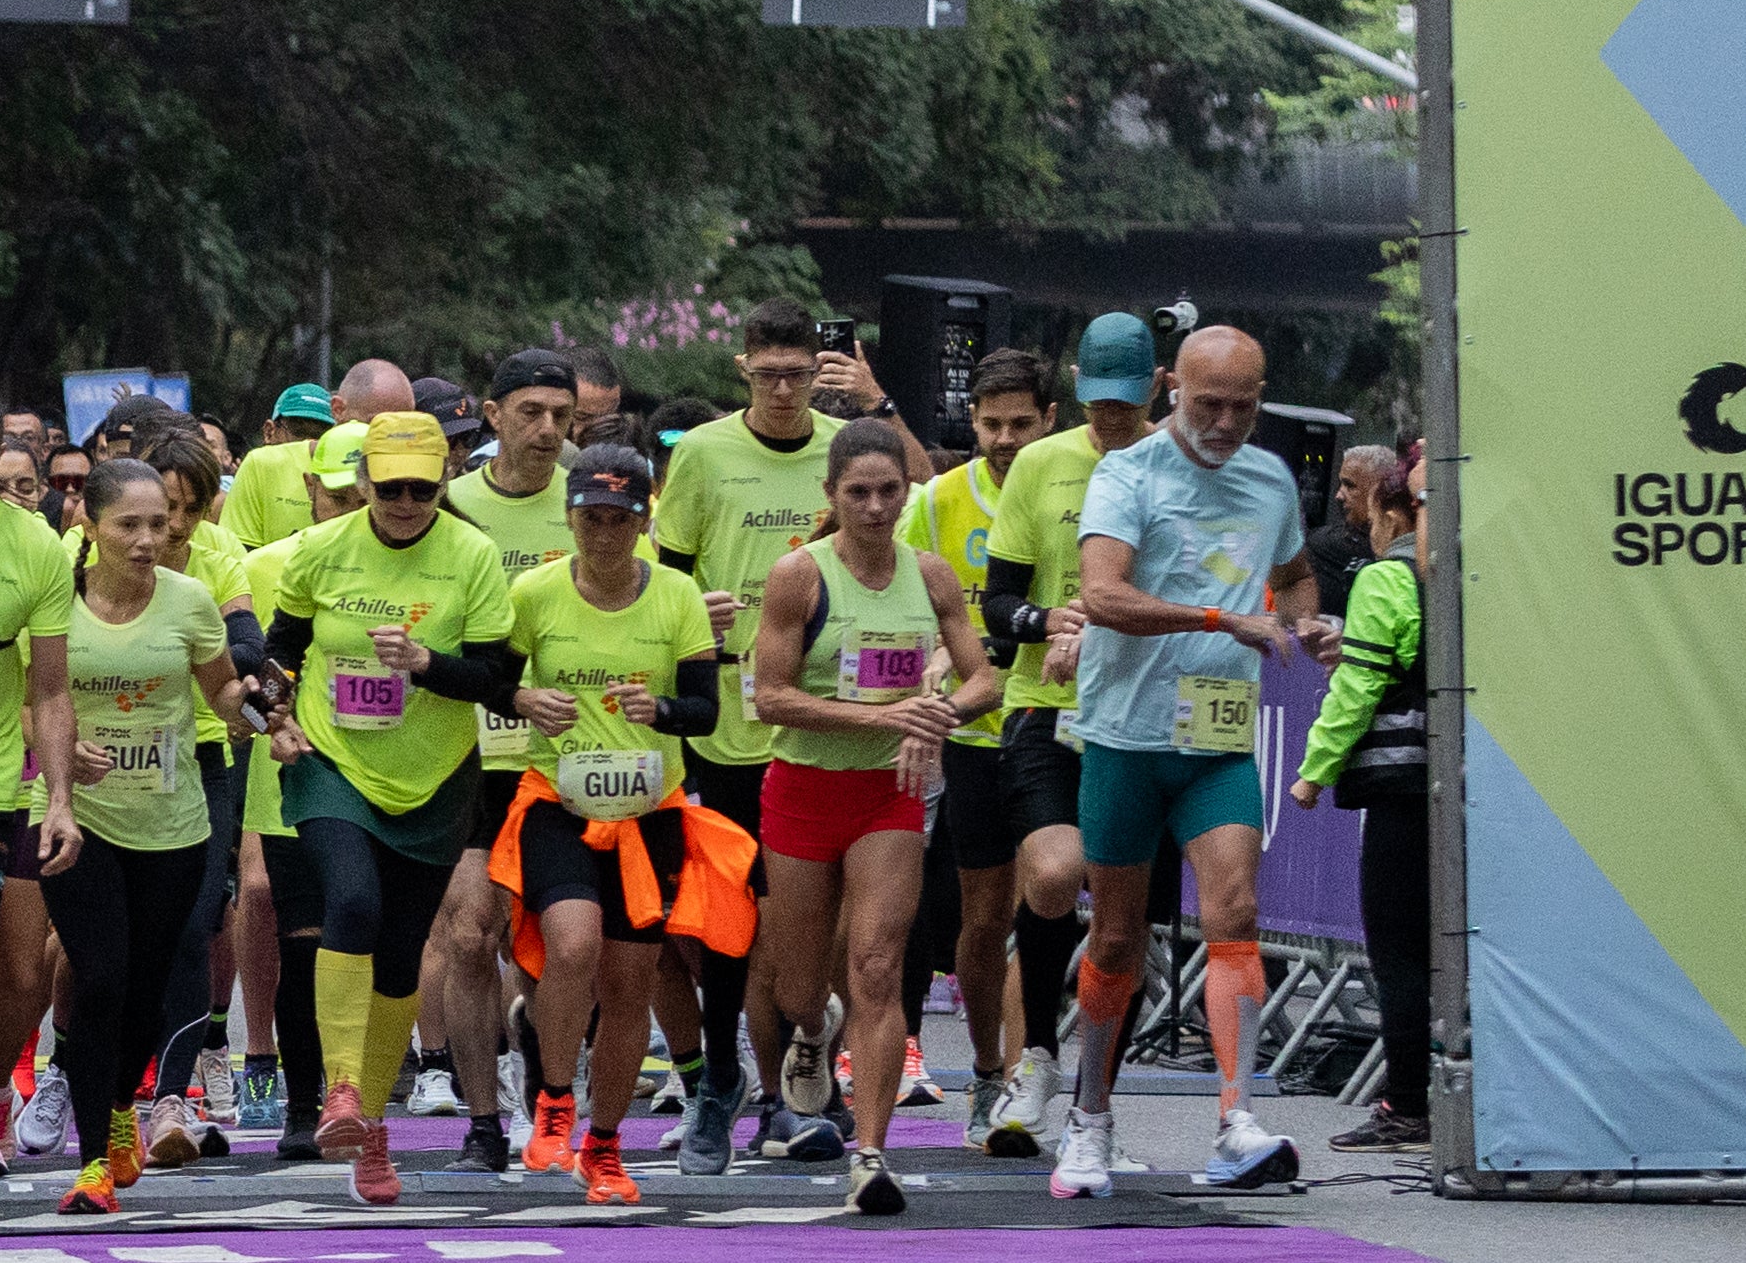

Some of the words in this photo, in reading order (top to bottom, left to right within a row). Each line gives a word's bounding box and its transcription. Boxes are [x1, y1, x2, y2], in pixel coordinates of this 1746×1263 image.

[742, 509, 811, 528] Achilles
[502, 550, 539, 567] illes
[331, 598, 405, 616] Achilles
[876, 652, 916, 676] 103
[72, 676, 142, 691] Achilles
[556, 669, 625, 686] Achilles
[348, 678, 393, 705] 105
[1208, 699, 1249, 726] 150
[103, 744, 162, 770] GUIA
[585, 771, 649, 798] GUIA
